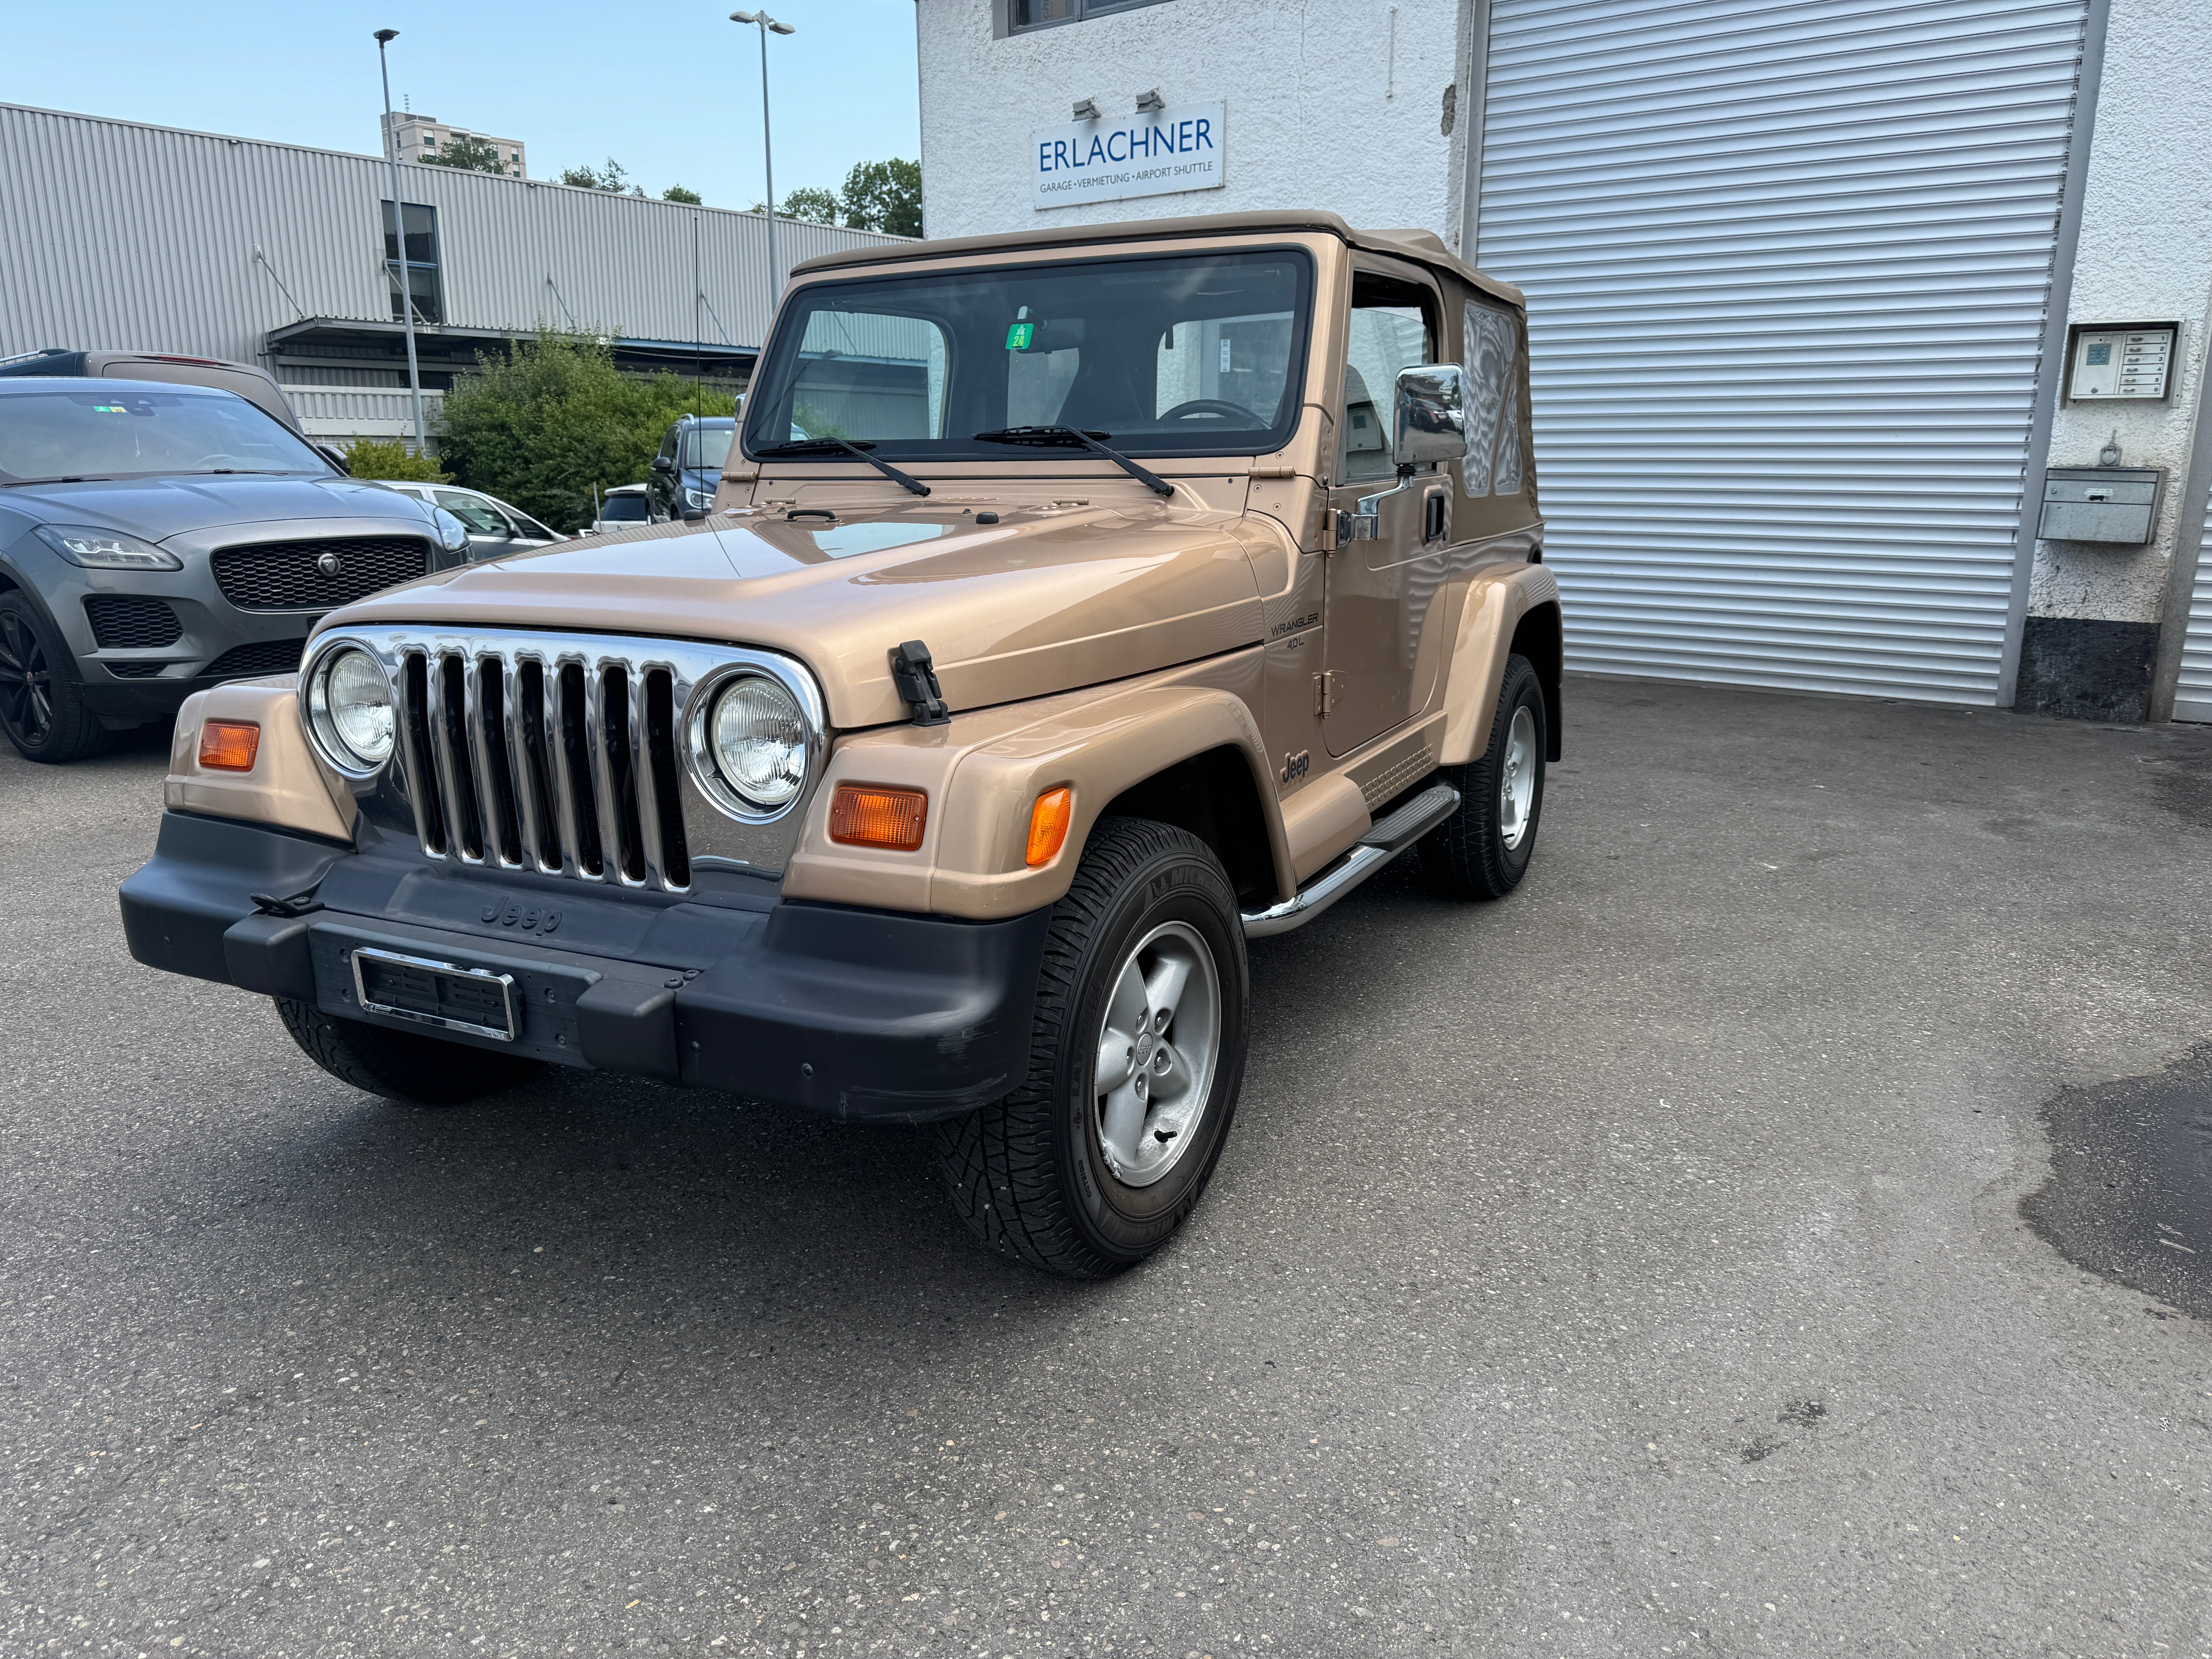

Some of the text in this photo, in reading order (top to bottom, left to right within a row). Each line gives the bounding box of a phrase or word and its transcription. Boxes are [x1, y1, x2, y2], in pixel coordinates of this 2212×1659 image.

[1040, 118, 1213, 172] ERLACHNER
[1040, 161, 1213, 193] GARAGE VERMIETUNG AIRPORT SHUTTLE
[1271, 613, 1318, 636] WRANGLER
[1282, 752, 1309, 783] Jeep
[1170, 867, 1231, 909] MICHELIN
[480, 896, 564, 936] Jeep
[1078, 1159, 1092, 1198] OUTSIDE
[1101, 1214, 1175, 1244] MICHELIN
